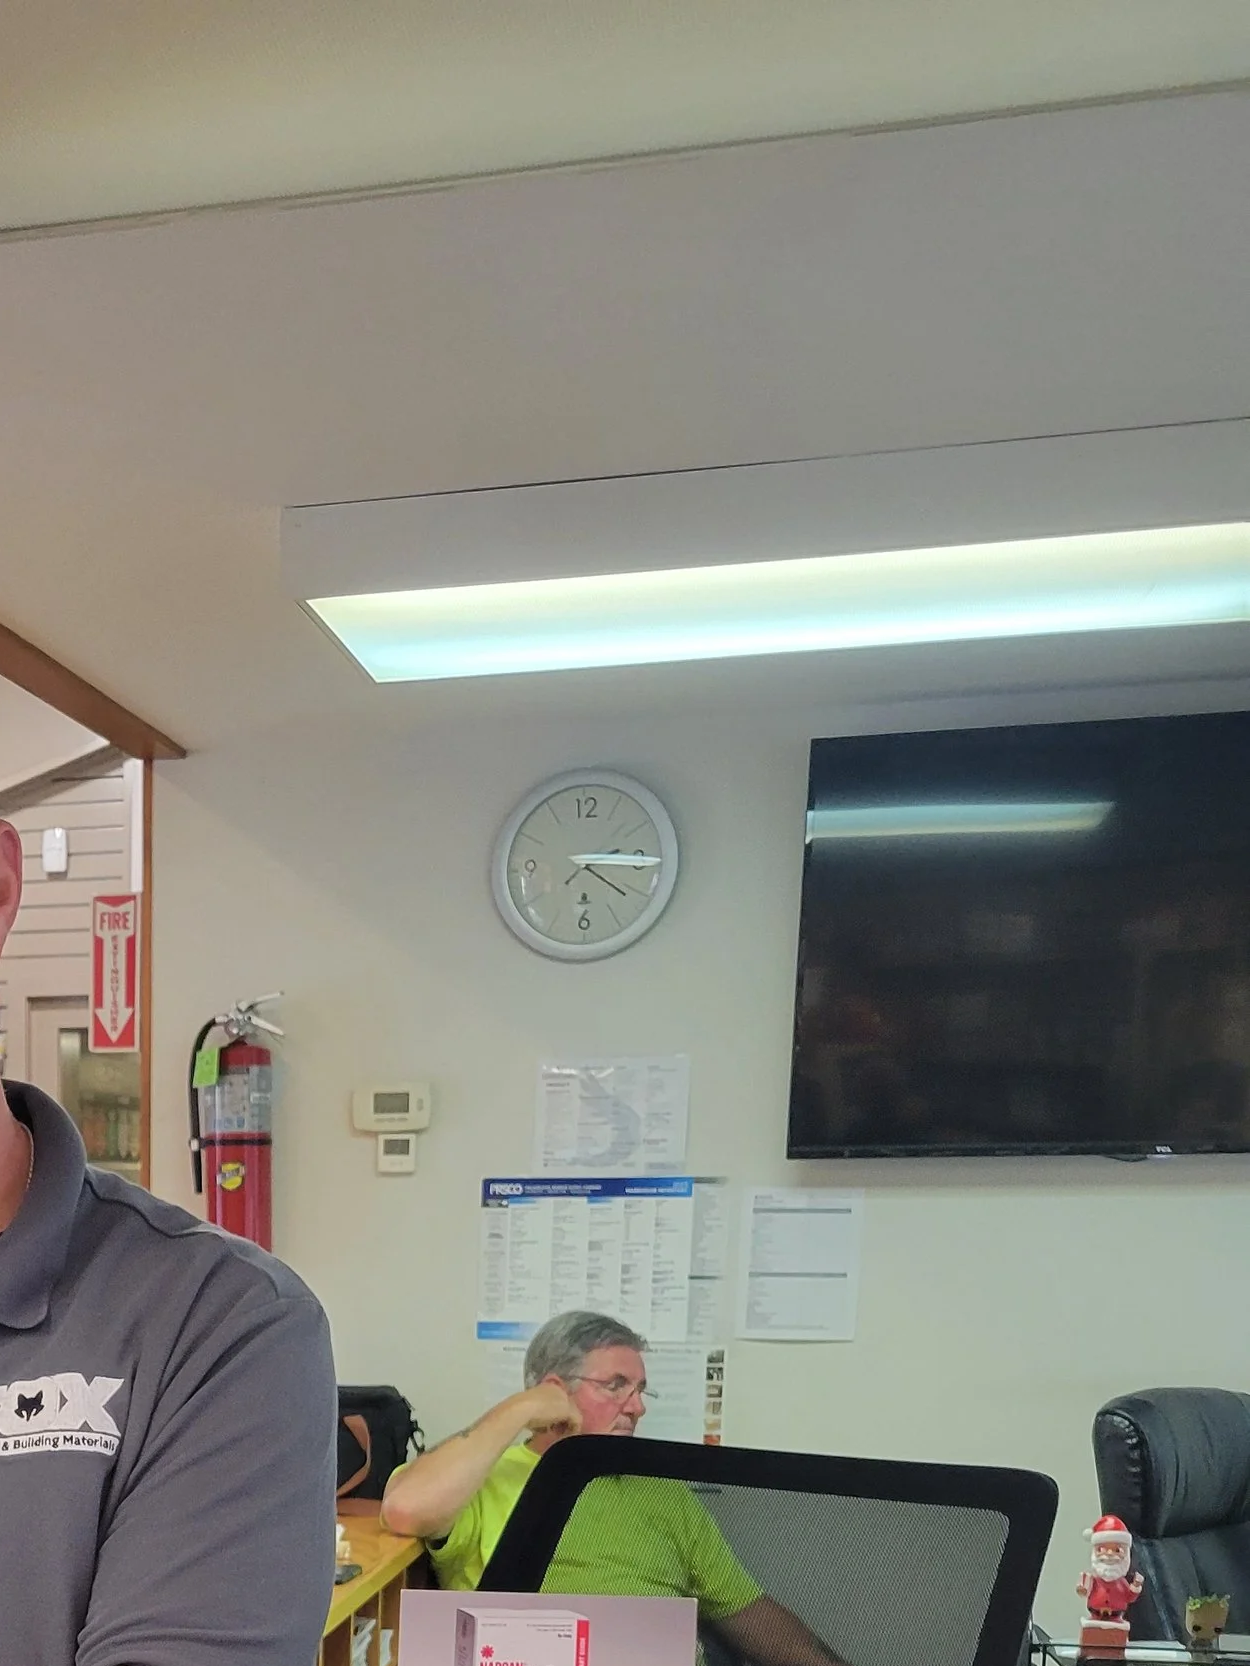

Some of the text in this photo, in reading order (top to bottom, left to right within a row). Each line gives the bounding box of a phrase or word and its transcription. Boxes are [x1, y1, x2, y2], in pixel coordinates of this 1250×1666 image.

[576, 797, 598, 818] 12
[525, 859, 537, 878] 9
[100, 912, 130, 930] FIRE
[578, 909, 590, 931] 6
[2, 1442, 9, 1451] &
[13, 1434, 58, 1449] Building
[63, 1434, 115, 1451] Materials
